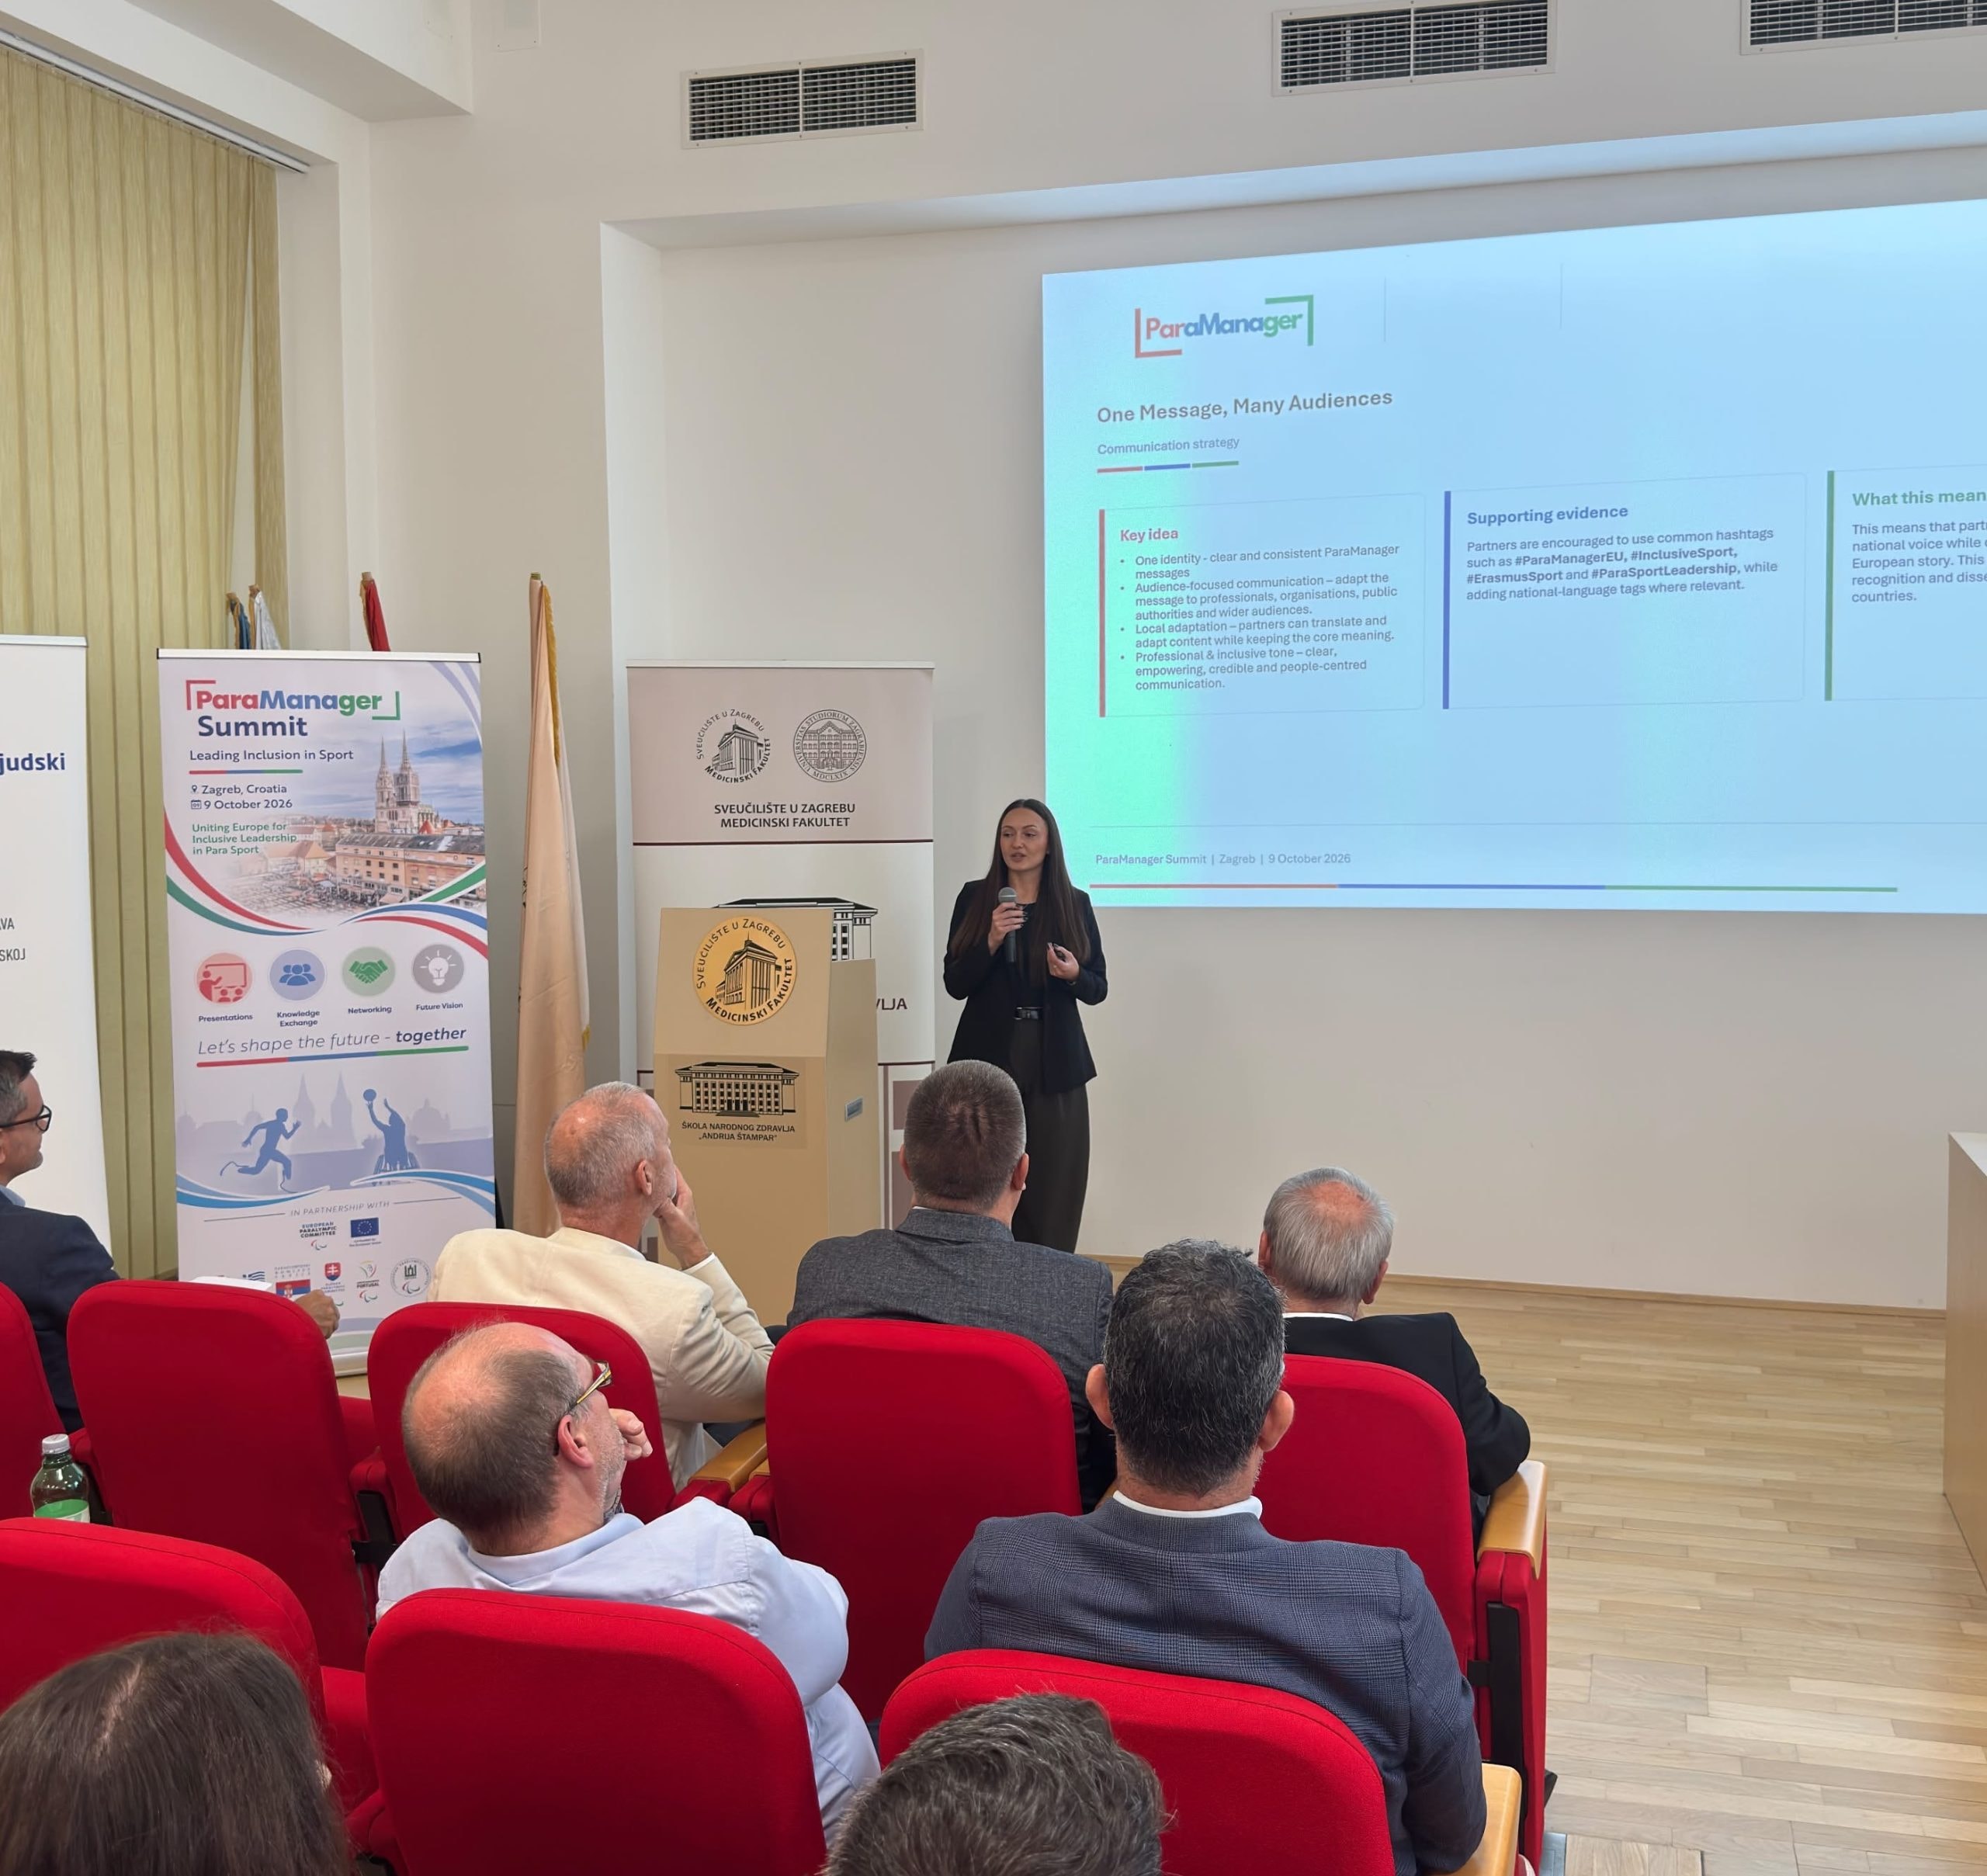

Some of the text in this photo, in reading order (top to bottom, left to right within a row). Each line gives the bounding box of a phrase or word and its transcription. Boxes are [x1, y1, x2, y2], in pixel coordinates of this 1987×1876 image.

[1146, 313, 1302, 339] ParaManager
[1098, 393, 1392, 422] One Message, Many Audiences
[1098, 439, 1240, 454] Communication strategy
[1853, 491, 1986, 506] What this mean
[1468, 507, 1628, 526] Supporting evidence
[1121, 528, 1178, 543] Key idea
[1852, 522, 1955, 534] This means that
[1468, 542, 1517, 552] Partners
[1541, 536, 1613, 548] encouraged
[1616, 536, 1629, 545] to
[1632, 536, 1654, 544] use
[1657, 532, 1712, 543] common
[1716, 529, 1774, 541] hashtags
[1853, 540, 1905, 551] national
[1909, 539, 1943, 550] voice
[1946, 537, 1981, 548] while
[1136, 546, 1399, 565] One identity clear and consistent ParaManager
[1467, 557, 1495, 567] such
[1515, 552, 1627, 565] #ParaManagerEU,
[1631, 547, 1737, 560] #InclusiveSport,
[1853, 554, 1984, 570] European story. This
[1136, 570, 1189, 580] messages
[1467, 561, 1777, 584] #ErasmusSport and #ParaSportLeadership, while
[1853, 573, 1953, 587] recognition and
[1135, 574, 1389, 593] Audience-focused communication adapt the
[1467, 580, 1744, 601] adding national-language tags where relevant.
[1136, 587, 1397, 607] message to professionals, organisations, public
[1852, 591, 1916, 602] countries.
[1136, 605, 1312, 620] authorities and wider audiences.
[1136, 623, 1165, 633] Local
[1168, 622, 1227, 634] adaptation
[1239, 621, 1285, 633] partners
[1312, 617, 1362, 627] translate
[1365, 616, 1386, 626] and
[1136, 630, 1394, 649] adapt content while keeping the core meaning.
[1136, 647, 1337, 662] Professional & inclusive tone clear,
[1136, 660, 1366, 678] empowering, credible and people-centred
[1136, 680, 1225, 690] communication.
[197, 691, 382, 716] ParaManager
[199, 716, 307, 737] Summit
[730, 709, 765, 732] ZAGREBU
[190, 750, 353, 762] Leading Inclusion in Sport
[705, 738, 771, 783] MEDICINSKI FAKULTET
[202, 785, 286, 796] Zagreb, Croatia
[204, 799, 292, 809] 9 October 2026
[714, 802, 855, 814] SVEUČILIŠTE U ZAGREBU
[192, 824, 230, 833] Uniting
[233, 823, 269, 832] Europe
[720, 817, 850, 827] MEDICINSKI FAKULTET
[241, 834, 296, 842] Leadership
[231, 846, 258, 855] Sport
[1096, 854, 1351, 866] ParaManager Summit Zagreb 9 October 2026
[742, 918, 786, 949] ZAGREBU
[706, 958, 792, 1022] MEDICINSKI FAKULTET
[241, 1039, 293, 1053] shape
[299, 1035, 324, 1048] the
[331, 1034, 380, 1049] future
[397, 1028, 466, 1045] together
[681, 1120, 707, 1129] ŠKOLA
[756, 1124, 796, 1132] ZDRAVLJA
[303, 1204, 364, 1215] PARTNERSHIP
